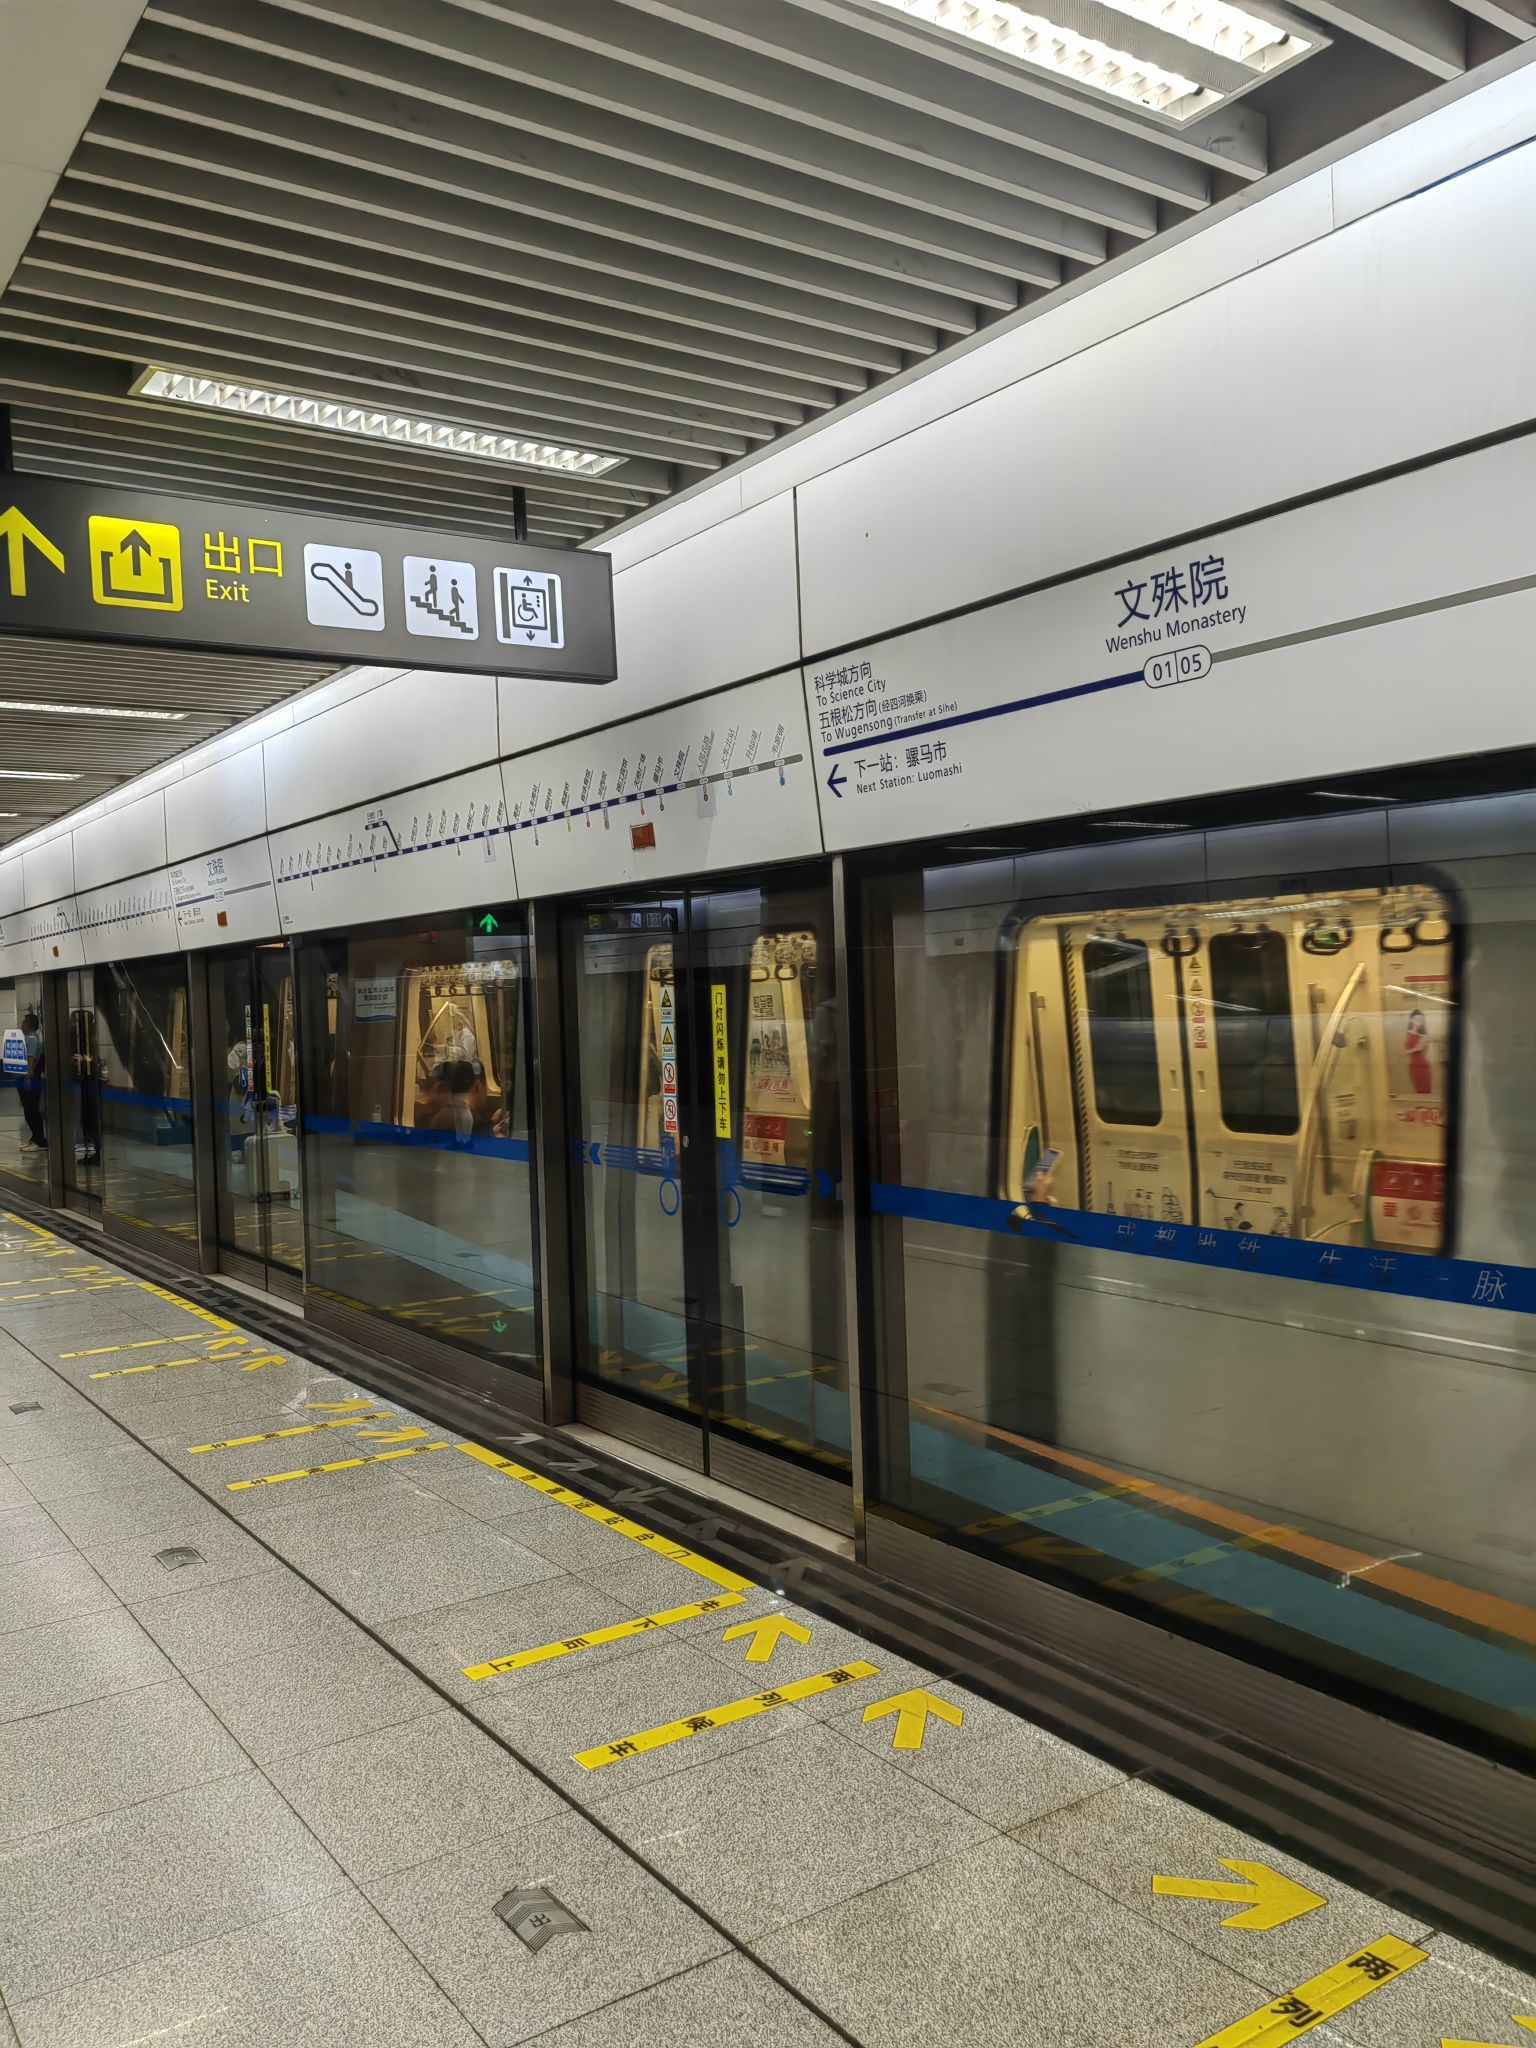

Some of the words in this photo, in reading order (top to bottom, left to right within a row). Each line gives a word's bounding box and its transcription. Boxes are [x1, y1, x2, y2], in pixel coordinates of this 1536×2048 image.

[204, 531, 283, 577] 出口
[206, 579, 250, 603] Exit
[1115, 554, 1229, 629] 文殊院
[1105, 627, 1162, 654] Wenshu
[1166, 605, 1246, 638] Monastery
[814, 661, 872, 693] 科学城方向
[816, 694, 828, 707] To
[830, 686, 865, 704] Science
[867, 678, 887, 693] City
[821, 731, 833, 743] To
[835, 716, 893, 739] Wugensong
[928, 707, 937, 717] at
[938, 701, 958, 715] Sihe)
[857, 782, 876, 794] Next
[880, 774, 915, 790] Station:
[917, 762, 963, 782] Luomashi
[489, 1599, 721, 1672] 先下后上
[609, 1669, 856, 1757] 两列候车
